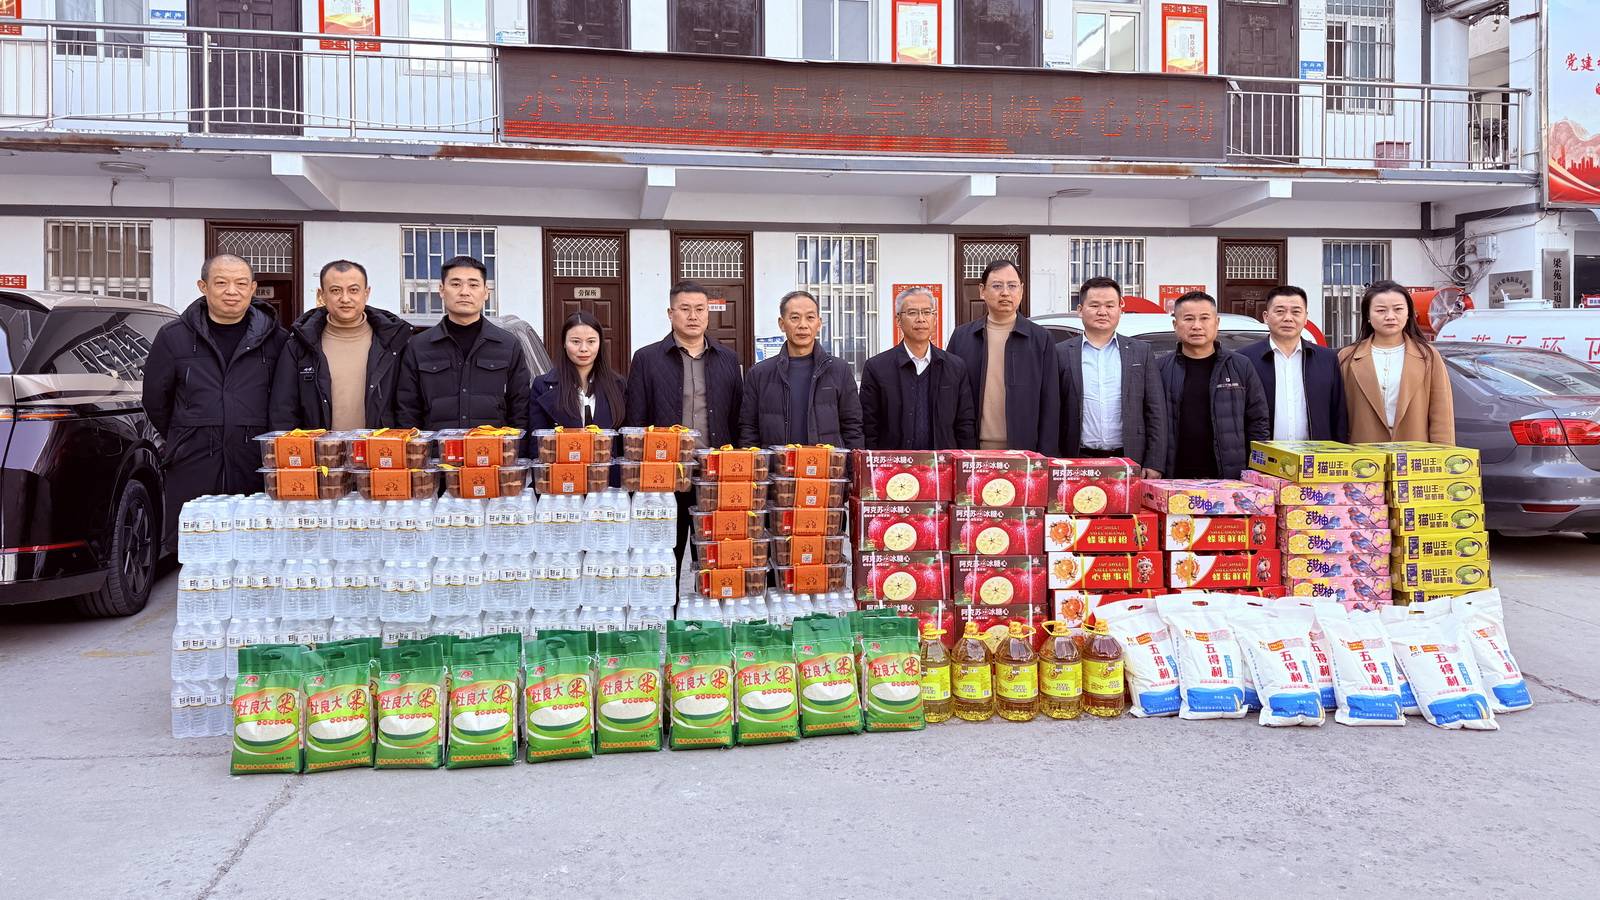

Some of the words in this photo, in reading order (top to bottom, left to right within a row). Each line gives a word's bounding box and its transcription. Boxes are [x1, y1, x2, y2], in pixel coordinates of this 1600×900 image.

[1565, 52, 1600, 72] 党建
[1149, 644, 1170, 679] 五得利
[1205, 644, 1222, 678] 五得利
[1280, 650, 1303, 682] 五得利
[1360, 652, 1382, 685] 五得利
[1436, 654, 1460, 686] 五得利
